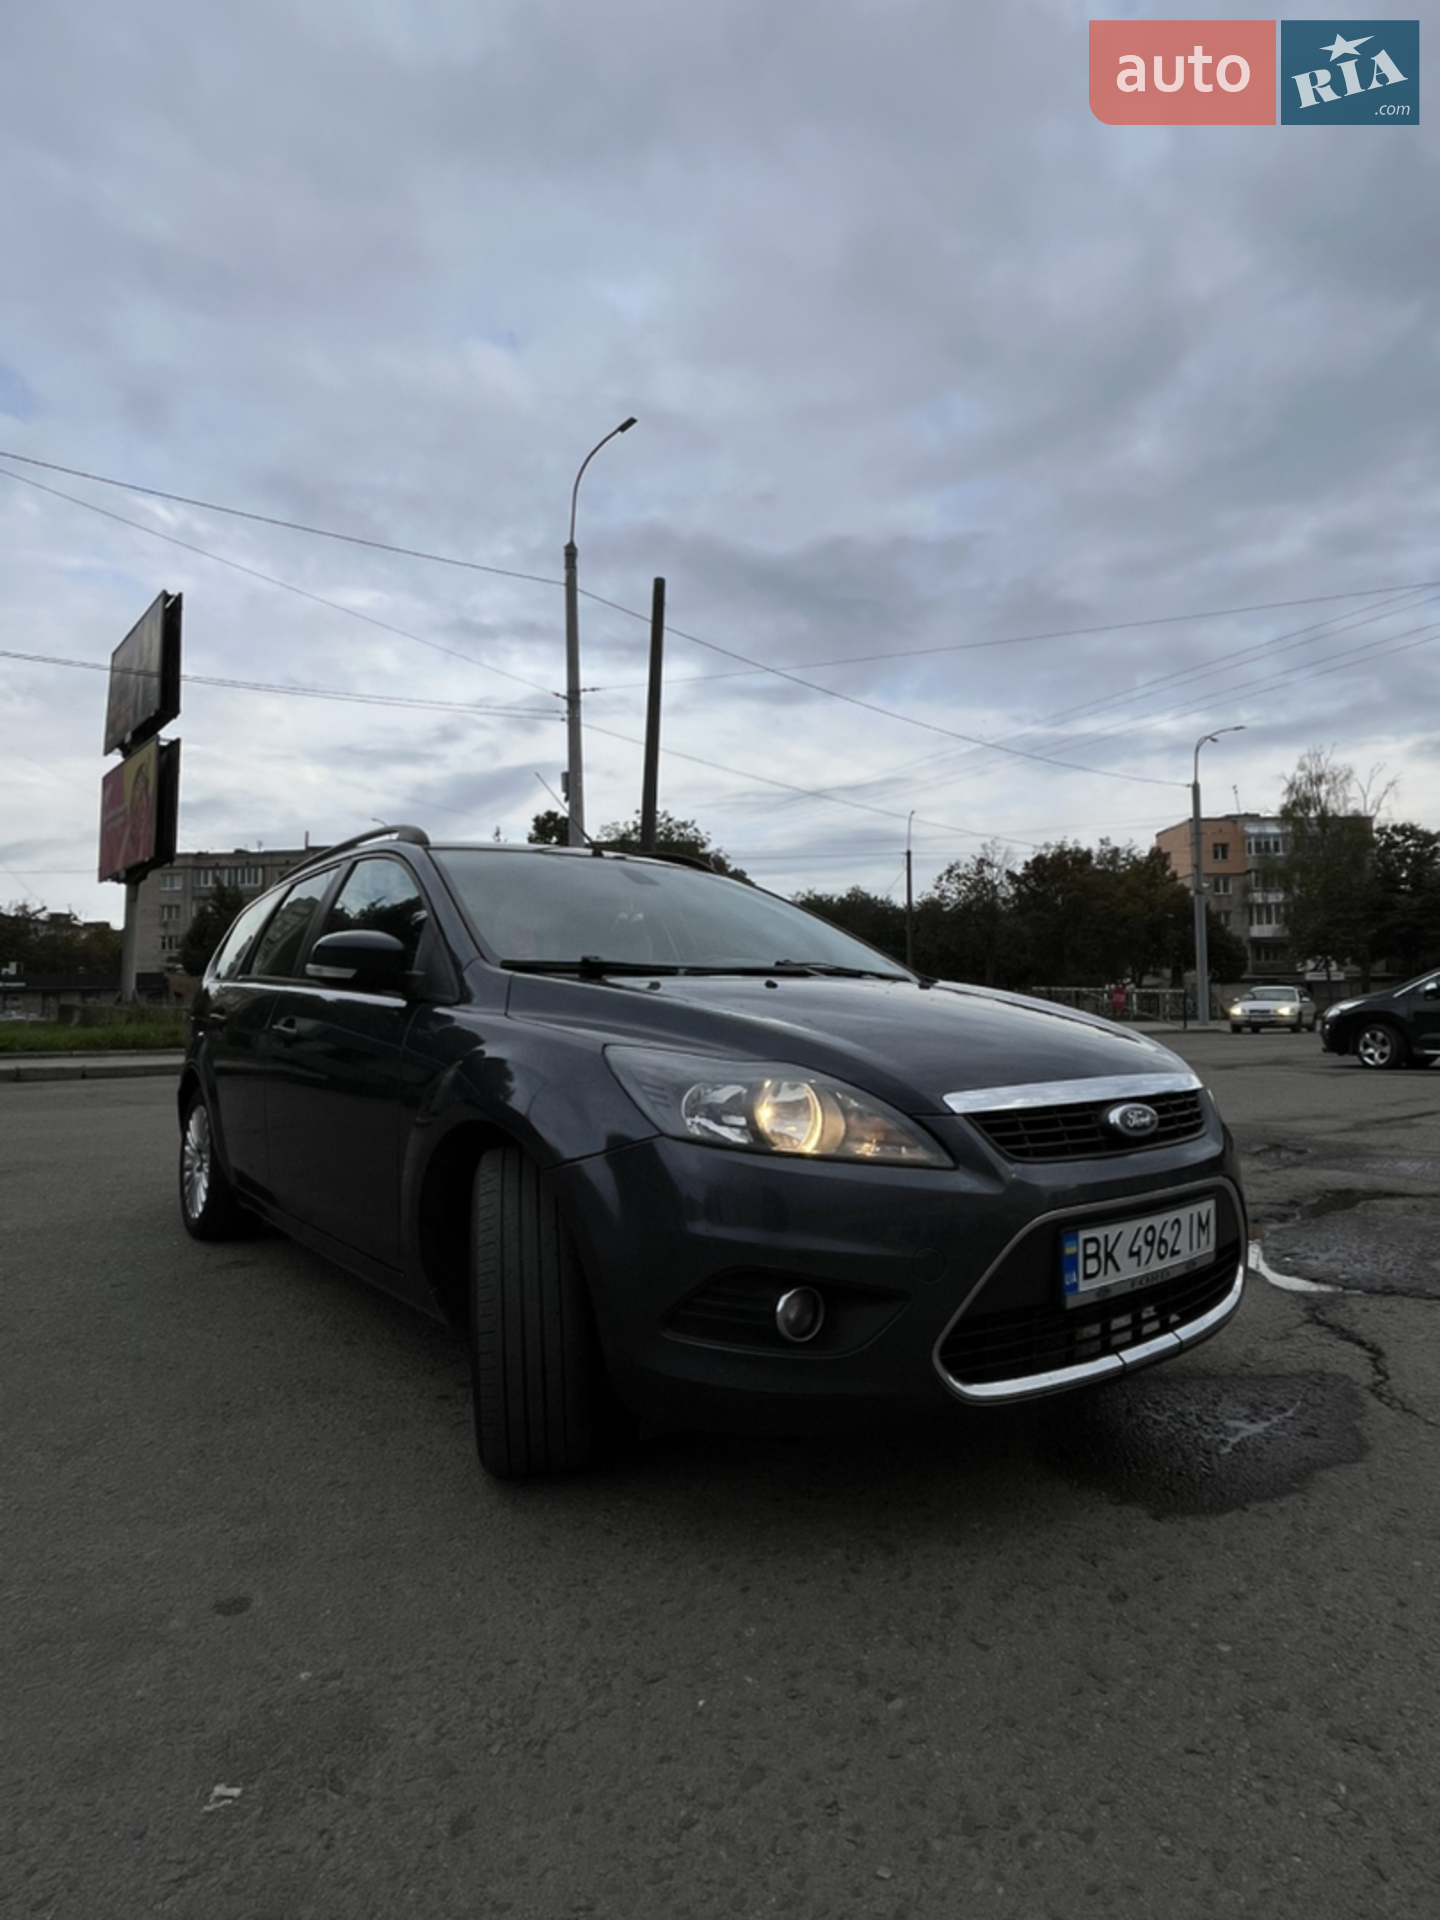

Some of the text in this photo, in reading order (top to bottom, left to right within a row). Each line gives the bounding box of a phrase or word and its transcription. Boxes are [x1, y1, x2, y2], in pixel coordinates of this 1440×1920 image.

[1126, 1110, 1151, 1128] Ford
[1082, 1207, 1212, 1281] BK 4962 IM
